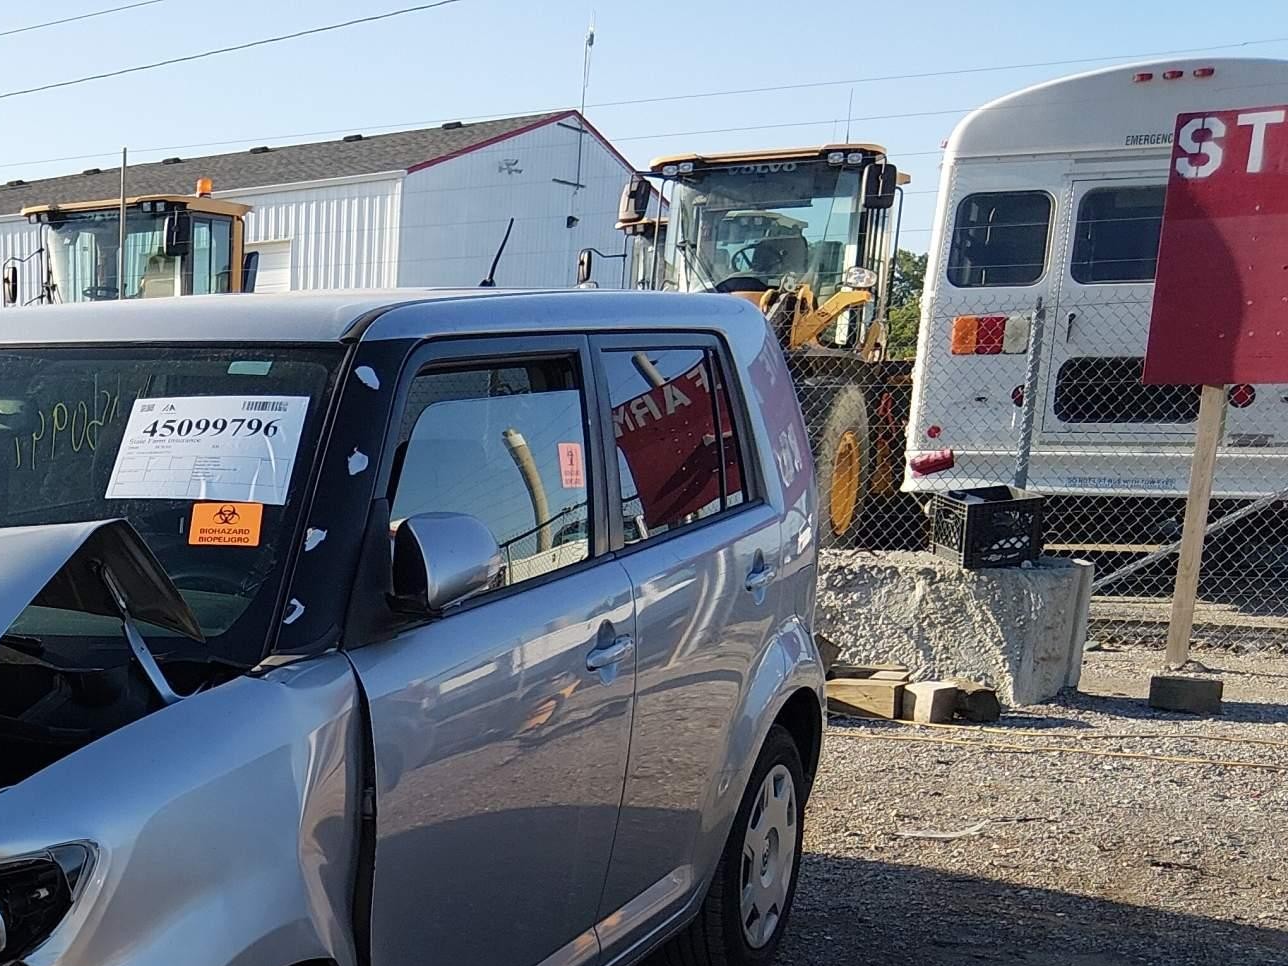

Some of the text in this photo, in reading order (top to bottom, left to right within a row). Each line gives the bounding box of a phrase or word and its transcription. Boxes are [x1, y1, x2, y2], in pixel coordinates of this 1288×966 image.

[727, 162, 797, 176] VOLVO
[142, 417, 282, 438] 45099796
[199, 527, 250, 535] BIOHAZARD
[198, 536, 250, 544] BIOPELIGRO
